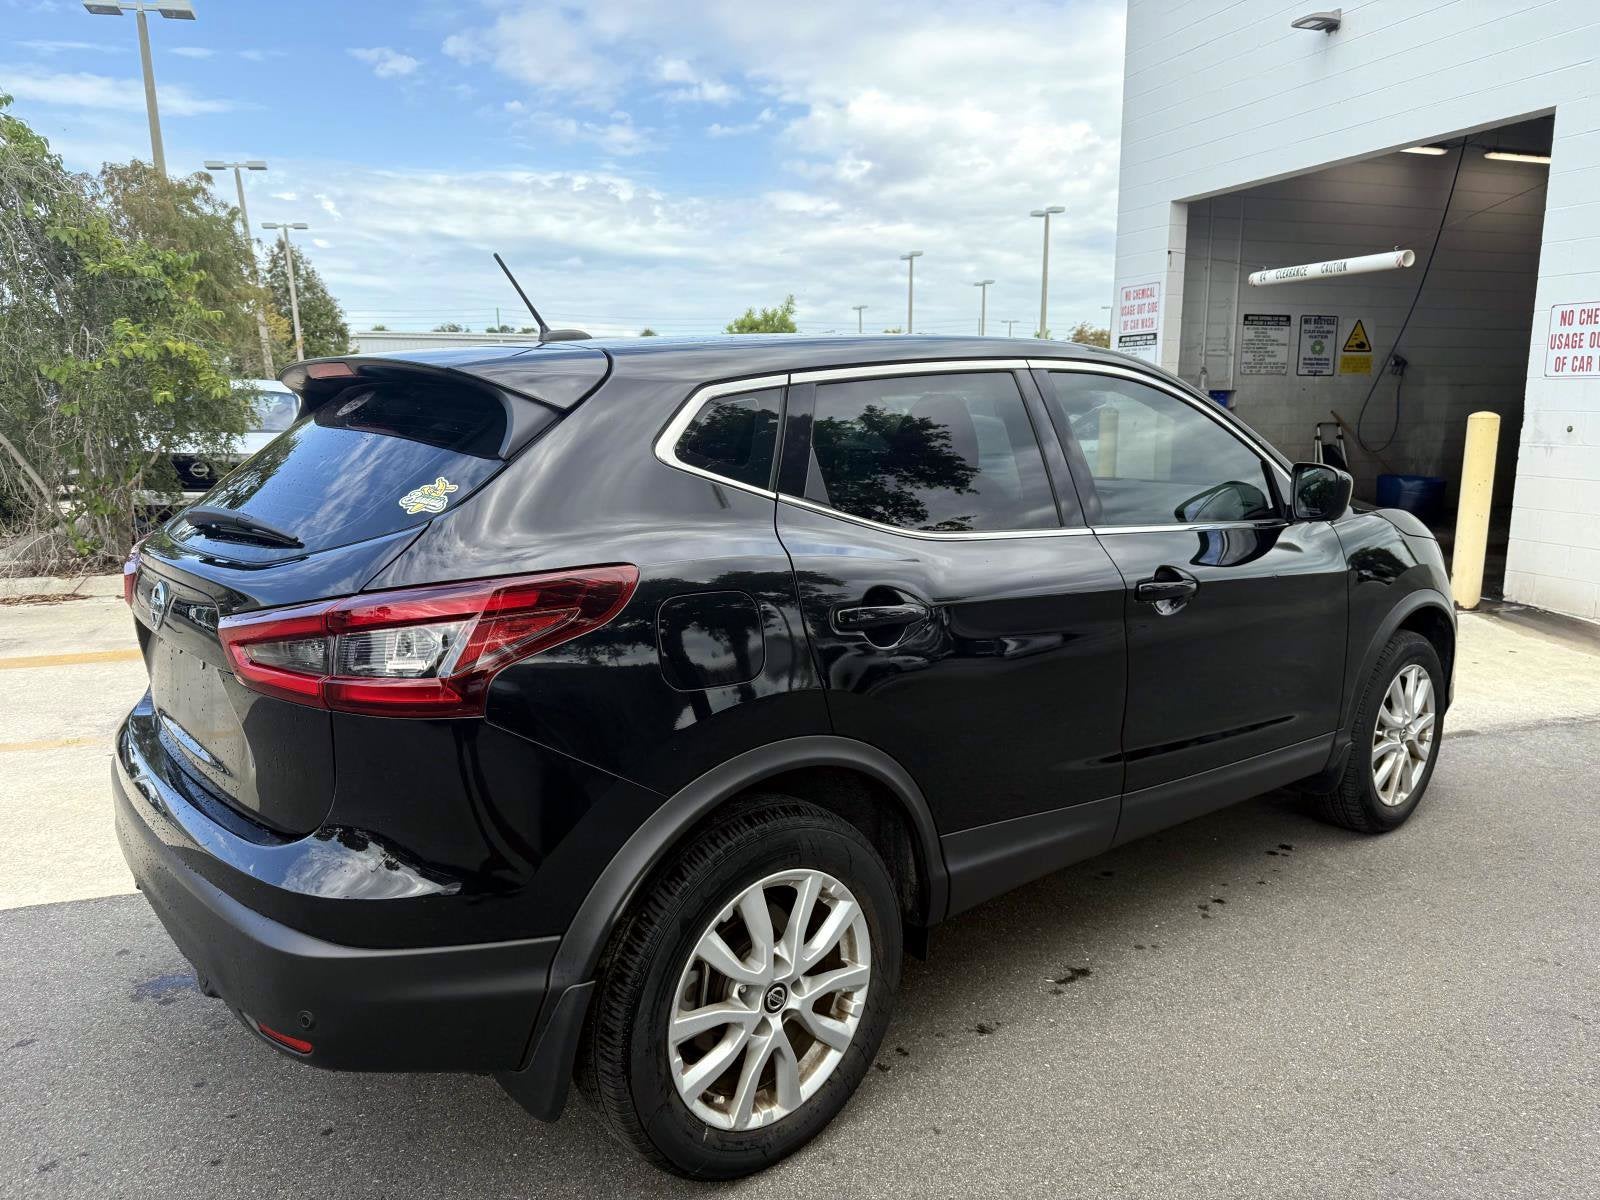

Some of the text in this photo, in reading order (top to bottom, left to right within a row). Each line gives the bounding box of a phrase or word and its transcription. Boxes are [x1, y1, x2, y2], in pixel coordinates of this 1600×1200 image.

[1276, 266, 1308, 280] CLEARANCE
[1321, 261, 1347, 274] CAUTION
[1125, 287, 1155, 301] NO CHEMICAL
[1121, 302, 1158, 317] USAGE OUT SIDE
[1560, 309, 1575, 327] NO
[1130, 319, 1139, 330] CAR
[1141, 317, 1154, 329] WASH
[1550, 333, 1585, 350] USAGE
[1554, 356, 1568, 373] OF
[1571, 356, 1593, 373] CAR
